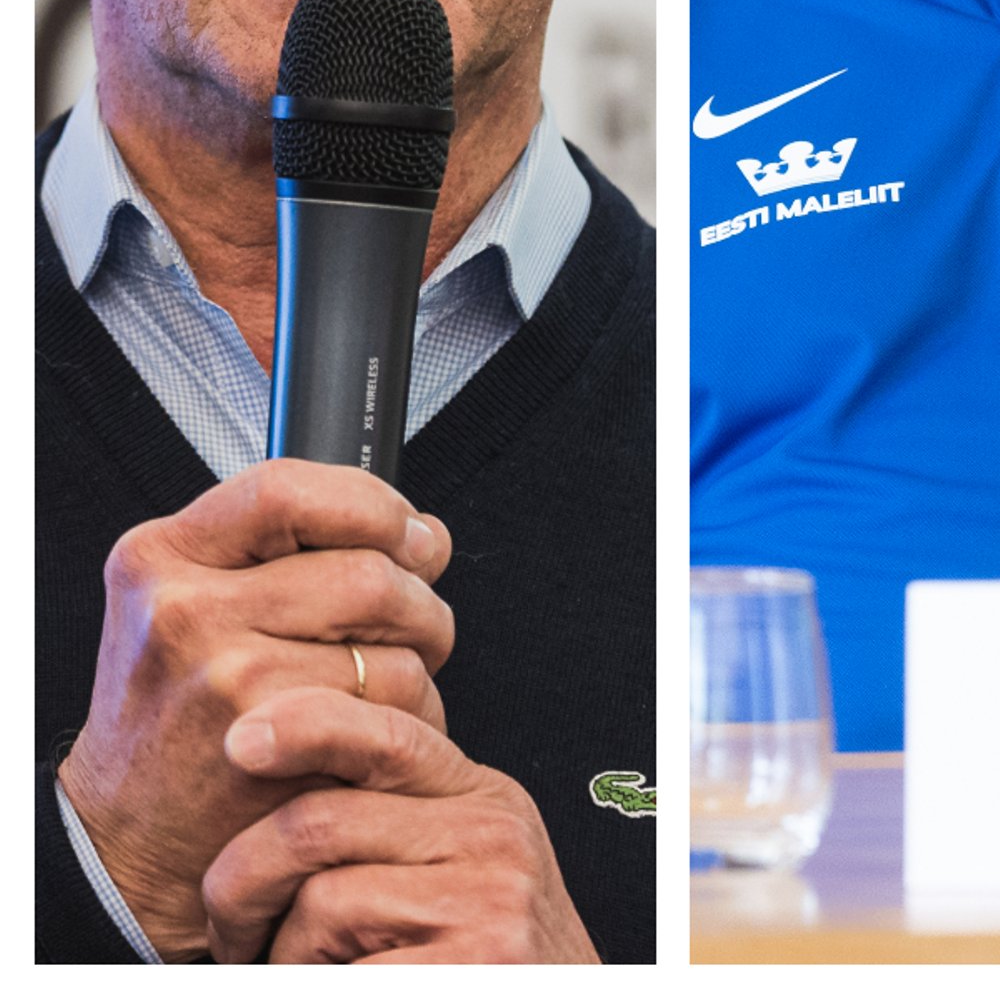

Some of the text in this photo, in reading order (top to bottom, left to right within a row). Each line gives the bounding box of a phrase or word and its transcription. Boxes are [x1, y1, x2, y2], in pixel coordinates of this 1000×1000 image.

[700, 181, 905, 247] EESTI MALELIIT
[361, 357, 379, 473] SER XS WIRELESS
